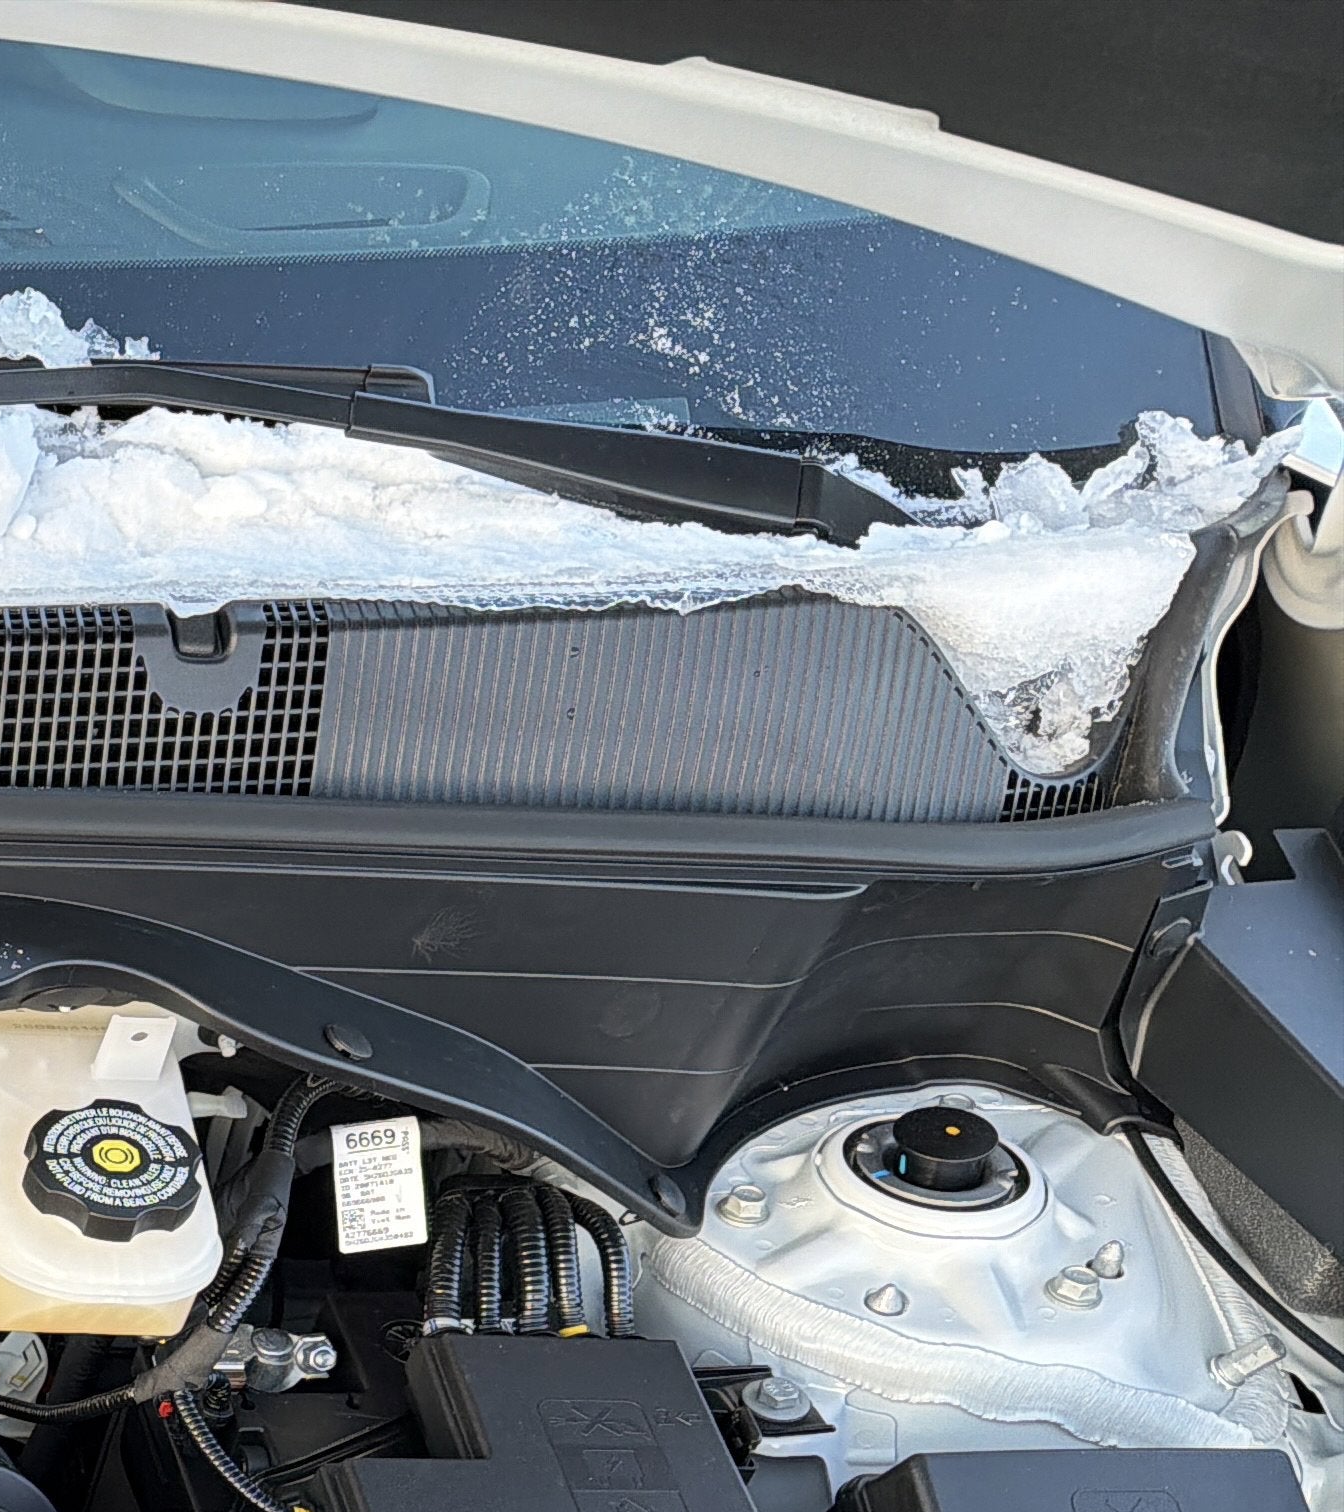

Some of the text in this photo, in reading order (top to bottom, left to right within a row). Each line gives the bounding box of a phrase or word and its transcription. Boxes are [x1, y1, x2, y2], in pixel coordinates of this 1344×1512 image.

[96, 1107, 108, 1116] LE
[93, 1117, 107, 1125] DU
[135, 1124, 149, 1134] DE
[345, 1128, 396, 1150] 6669
[67, 1170, 103, 1192] BEFORE
[109, 1178, 143, 1187] CLEAN
[82, 1189, 113, 1205] FROM
[113, 1197, 122, 1206] A
[121, 1193, 160, 1206] SEALED
